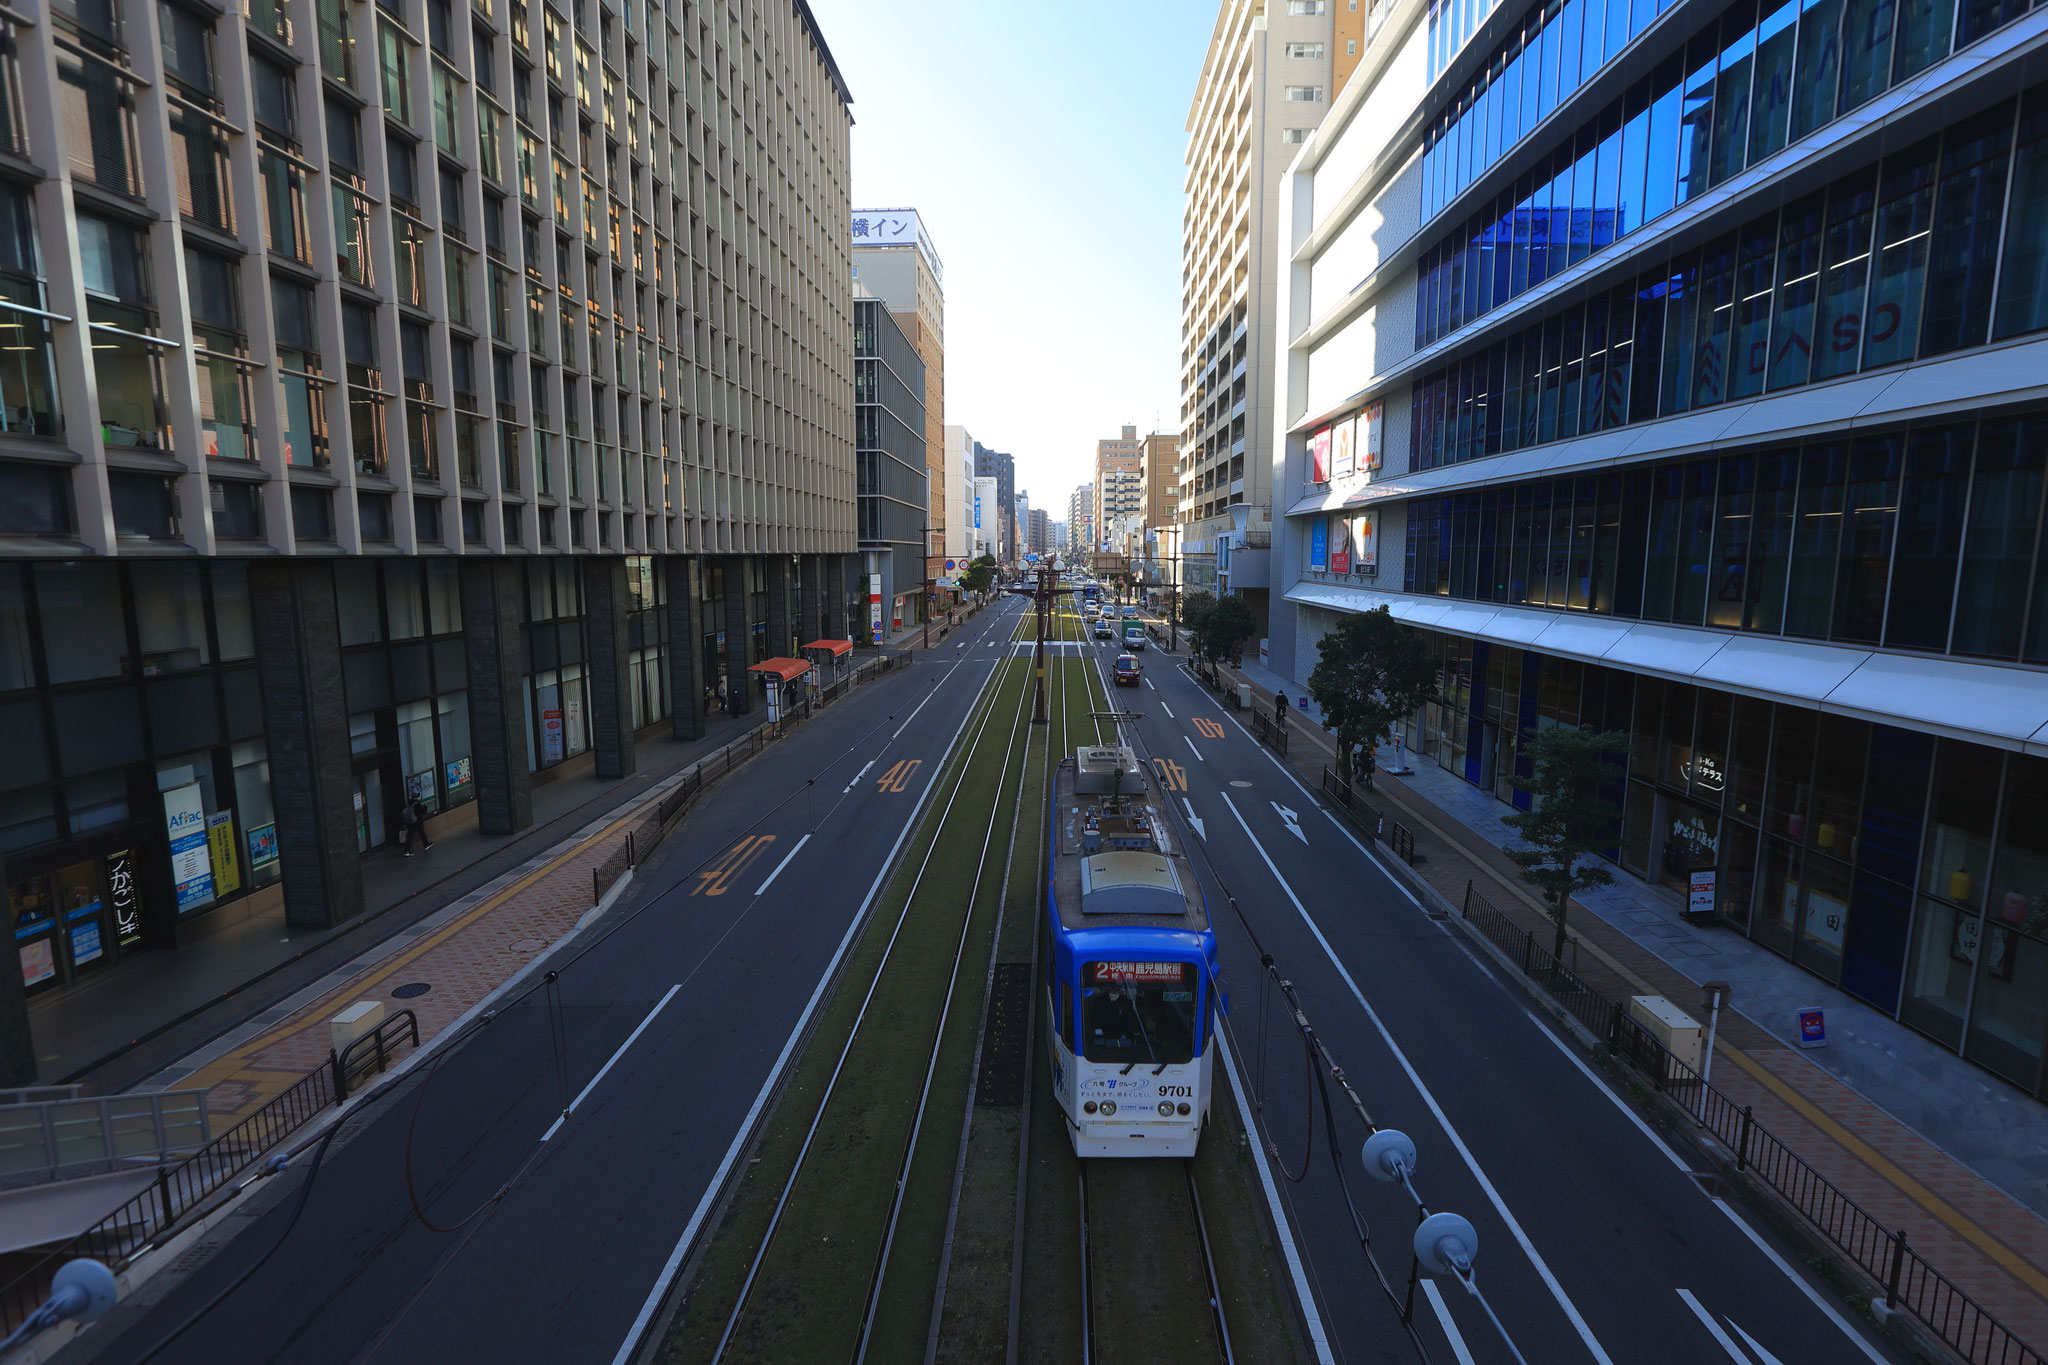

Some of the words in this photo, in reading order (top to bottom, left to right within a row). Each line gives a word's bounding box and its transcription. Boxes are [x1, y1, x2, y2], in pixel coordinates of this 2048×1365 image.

[1191, 718, 1225, 738] 40
[876, 759, 923, 793] 40
[1096, 962, 1109, 979] 2
[1135, 962, 1182, 975] 鹿児島駅前
[1158, 1085, 1193, 1098] 9701
